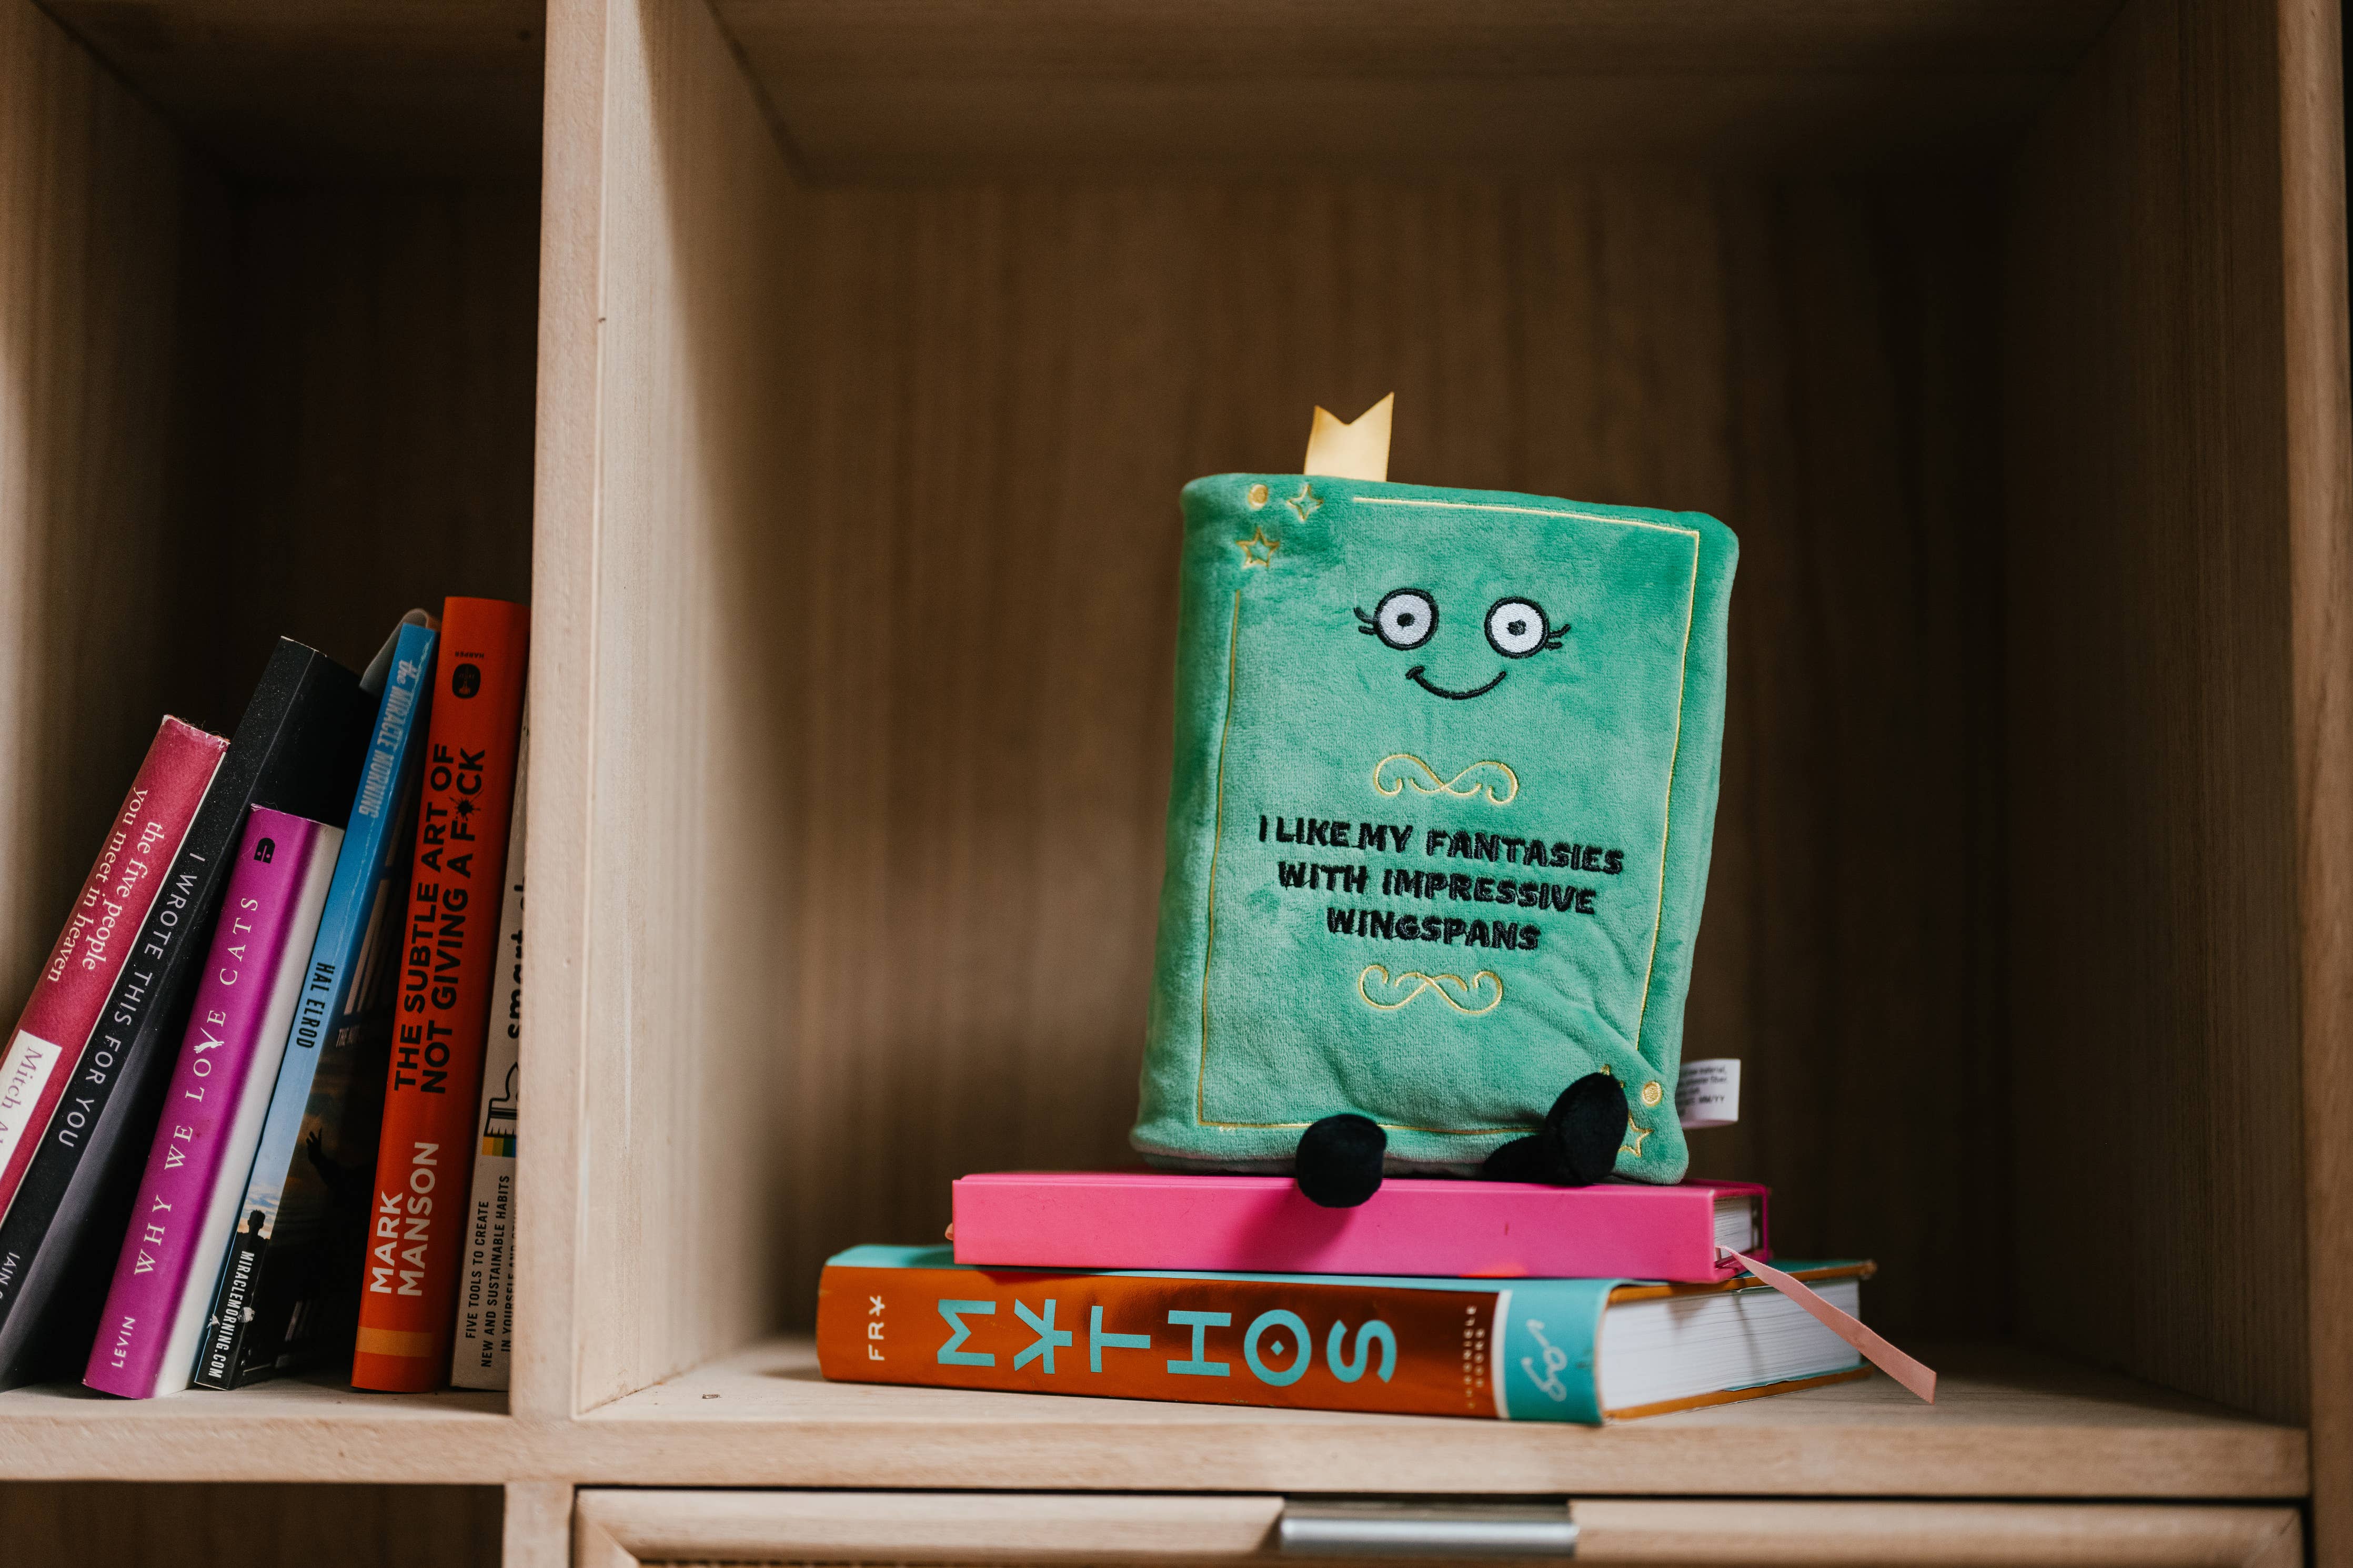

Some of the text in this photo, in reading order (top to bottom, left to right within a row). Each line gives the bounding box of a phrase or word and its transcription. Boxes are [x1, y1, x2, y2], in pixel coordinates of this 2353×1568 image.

[358, 660, 418, 818] the MIRACLE MORNING
[48, 787, 148, 982] you meet in heaven
[82, 822, 165, 970] the five people
[447, 853, 473, 879] A
[1259, 815, 1624, 875] I LIKE MY FANTASIES
[1278, 862, 1597, 915] WITH IMPRESSIVE
[394, 744, 454, 1091] THE SUBTLE ART OF
[431, 888, 468, 1010] GIVING
[1326, 907, 1541, 950] WINGSPANS
[58, 853, 206, 1147] I WROTE THIS FOR YOU
[296, 962, 336, 1048] HAL ELROD
[2, 1047, 43, 1109] Mitch
[134, 1195, 173, 1274] WHY
[164, 1124, 193, 1171] WE
[219, 897, 258, 986] CATS
[420, 1020, 453, 1094] NOT
[369, 1190, 404, 1293] MARK
[397, 1141, 439, 1297] MANSON
[466, 1201, 489, 1339] FIVE TOOLS TO CREATE
[208, 1250, 255, 1379] MIRACLEMORNING.COM
[481, 1176, 510, 1368] NEW AND SUSTAINABLE HABITS
[111, 1317, 136, 1368] LEVIN
[501, 1340, 511, 1352] IN
[868, 1295, 886, 1361] FRY
[938, 1298, 1397, 1387] MYTHOS
